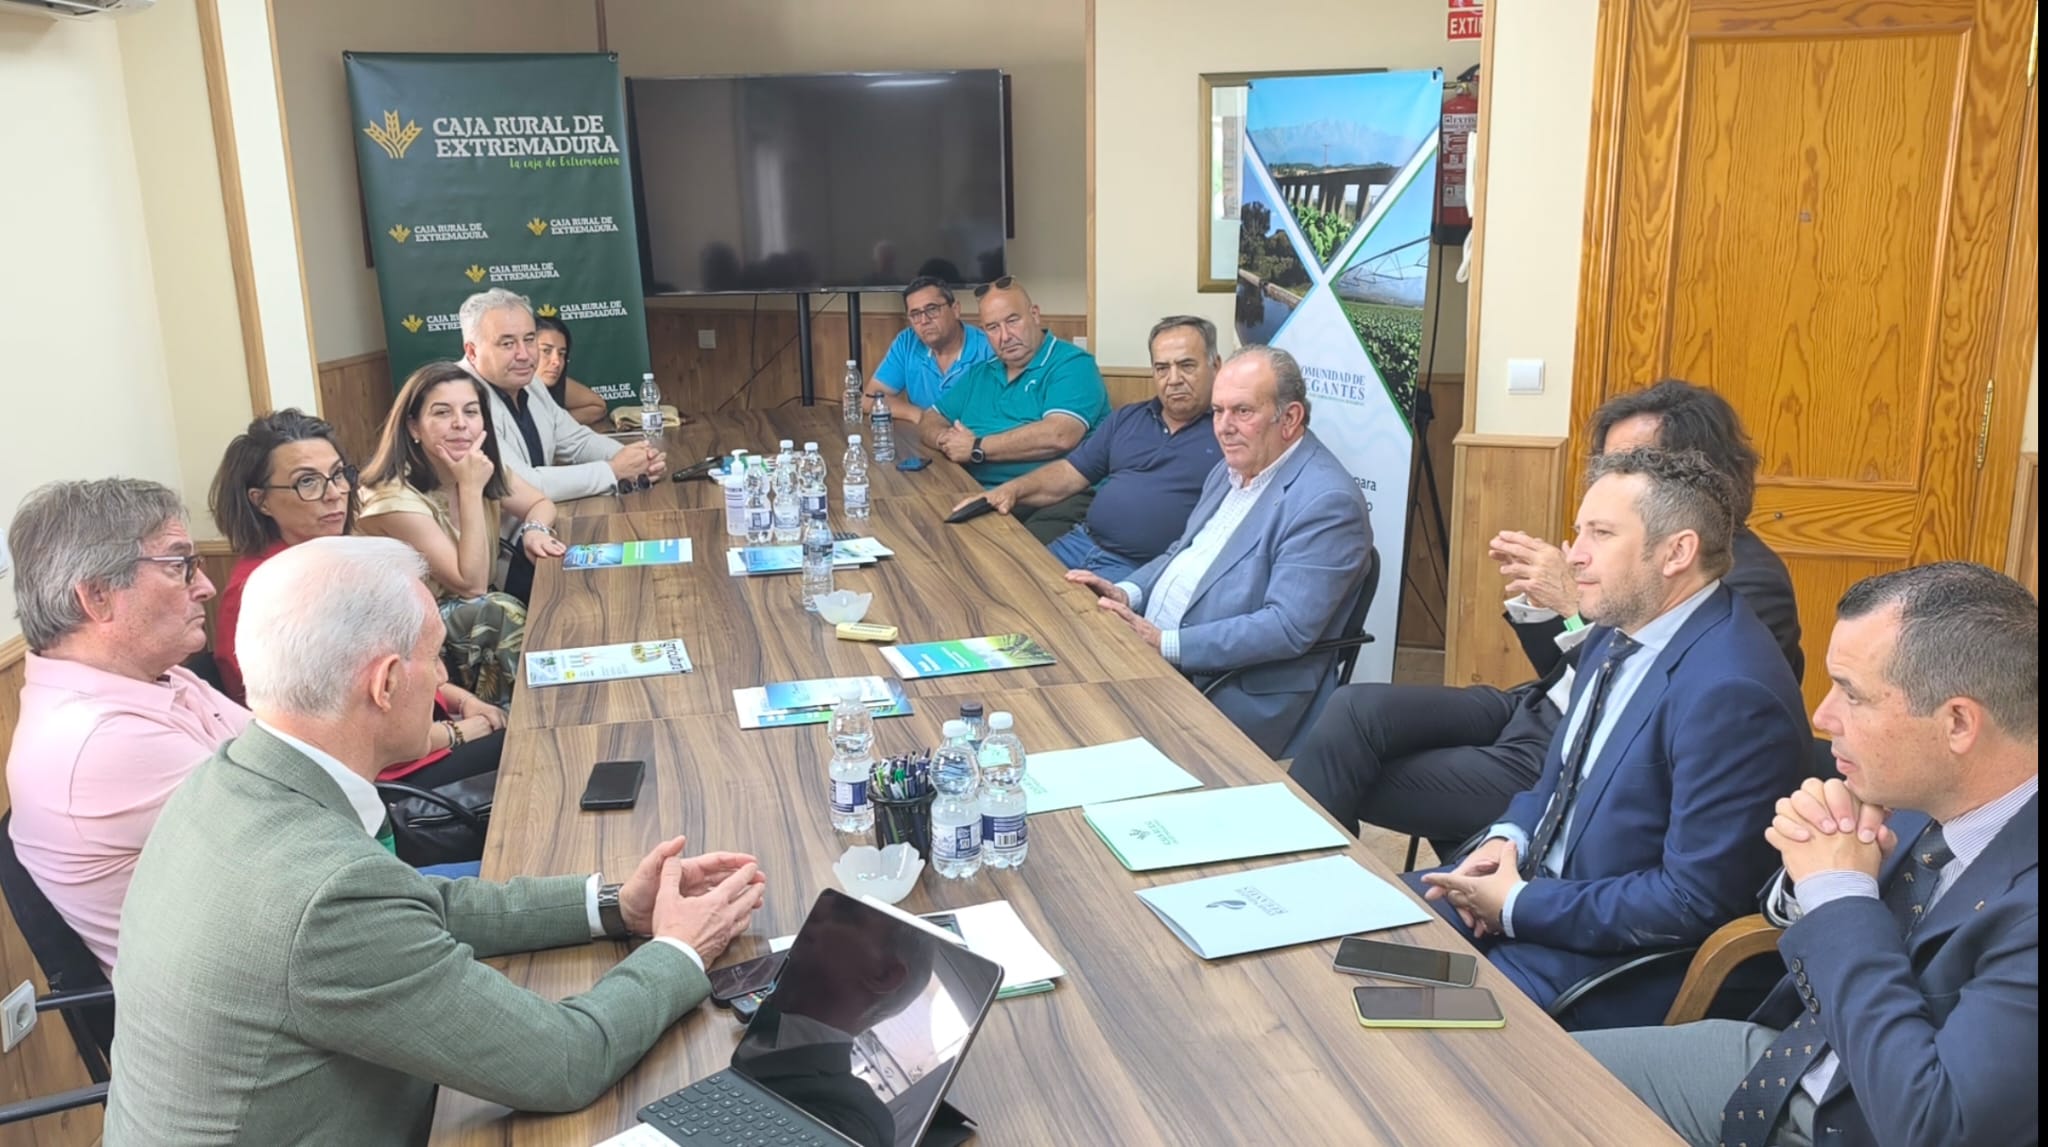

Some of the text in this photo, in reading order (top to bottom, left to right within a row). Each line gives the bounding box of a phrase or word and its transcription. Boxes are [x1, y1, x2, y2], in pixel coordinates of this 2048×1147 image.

[433, 115, 604, 137] CAJA RURAL DE
[435, 135, 619, 157] EXTREMADURA
[545, 156, 556, 168] de
[559, 156, 620, 168] Extremadura
[550, 216, 613, 227] CAJA RURAL DE
[414, 222, 483, 234] CAJA RURAL DE
[551, 224, 619, 235] EXTREMADURA
[415, 230, 489, 242] EXTREMADURA
[489, 262, 554, 273] CAJA RURAL DE
[490, 270, 560, 282] EXTREMADURA
[560, 300, 622, 312] CAJA RURAL DE
[426, 314, 449, 323] CAJA
[561, 308, 628, 320] EXTREMADURA
[427, 321, 462, 332] EXTRE
[1301, 365, 1366, 386] OMUNIDAD DE
[619, 383, 631, 391] DE
[1303, 377, 1365, 400] EGANTES
[600, 390, 637, 400] MADURA
